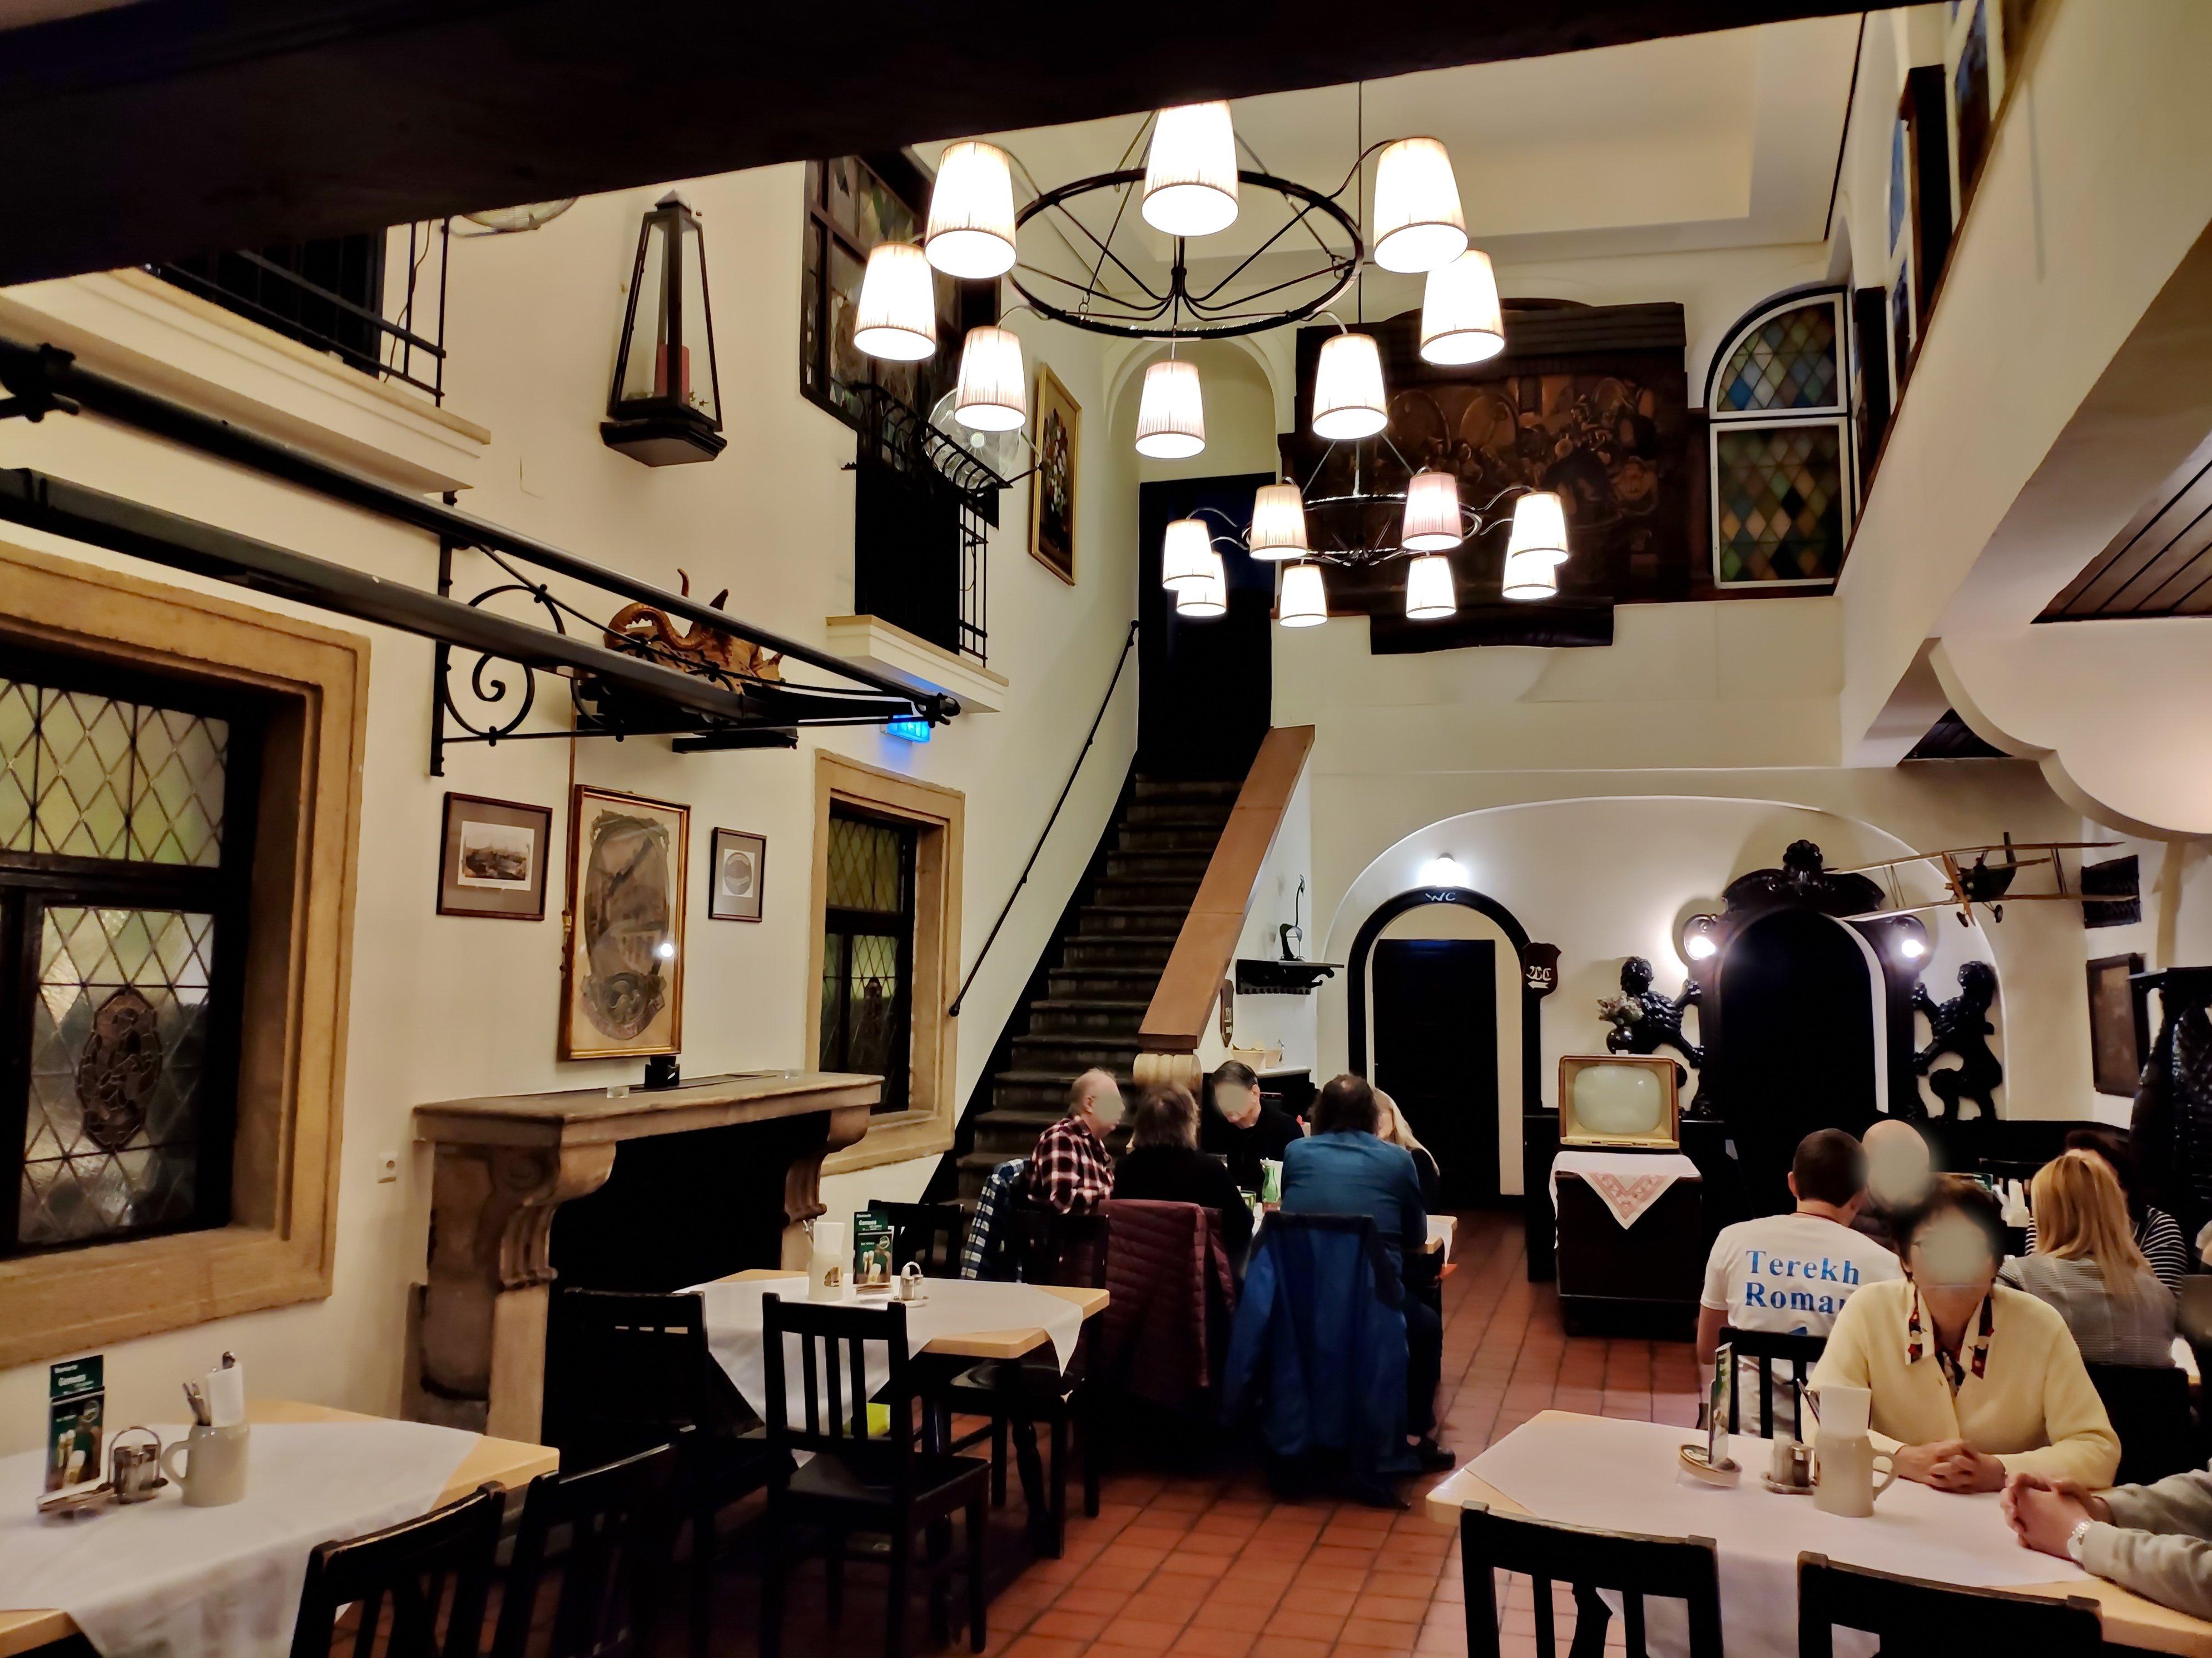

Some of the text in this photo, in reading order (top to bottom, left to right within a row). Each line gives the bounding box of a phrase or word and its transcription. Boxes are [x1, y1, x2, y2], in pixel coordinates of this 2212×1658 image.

[1425, 892, 1456, 901] WC
[1746, 1250, 1859, 1285] Terekh
[1745, 1282, 1846, 1314] Roma
